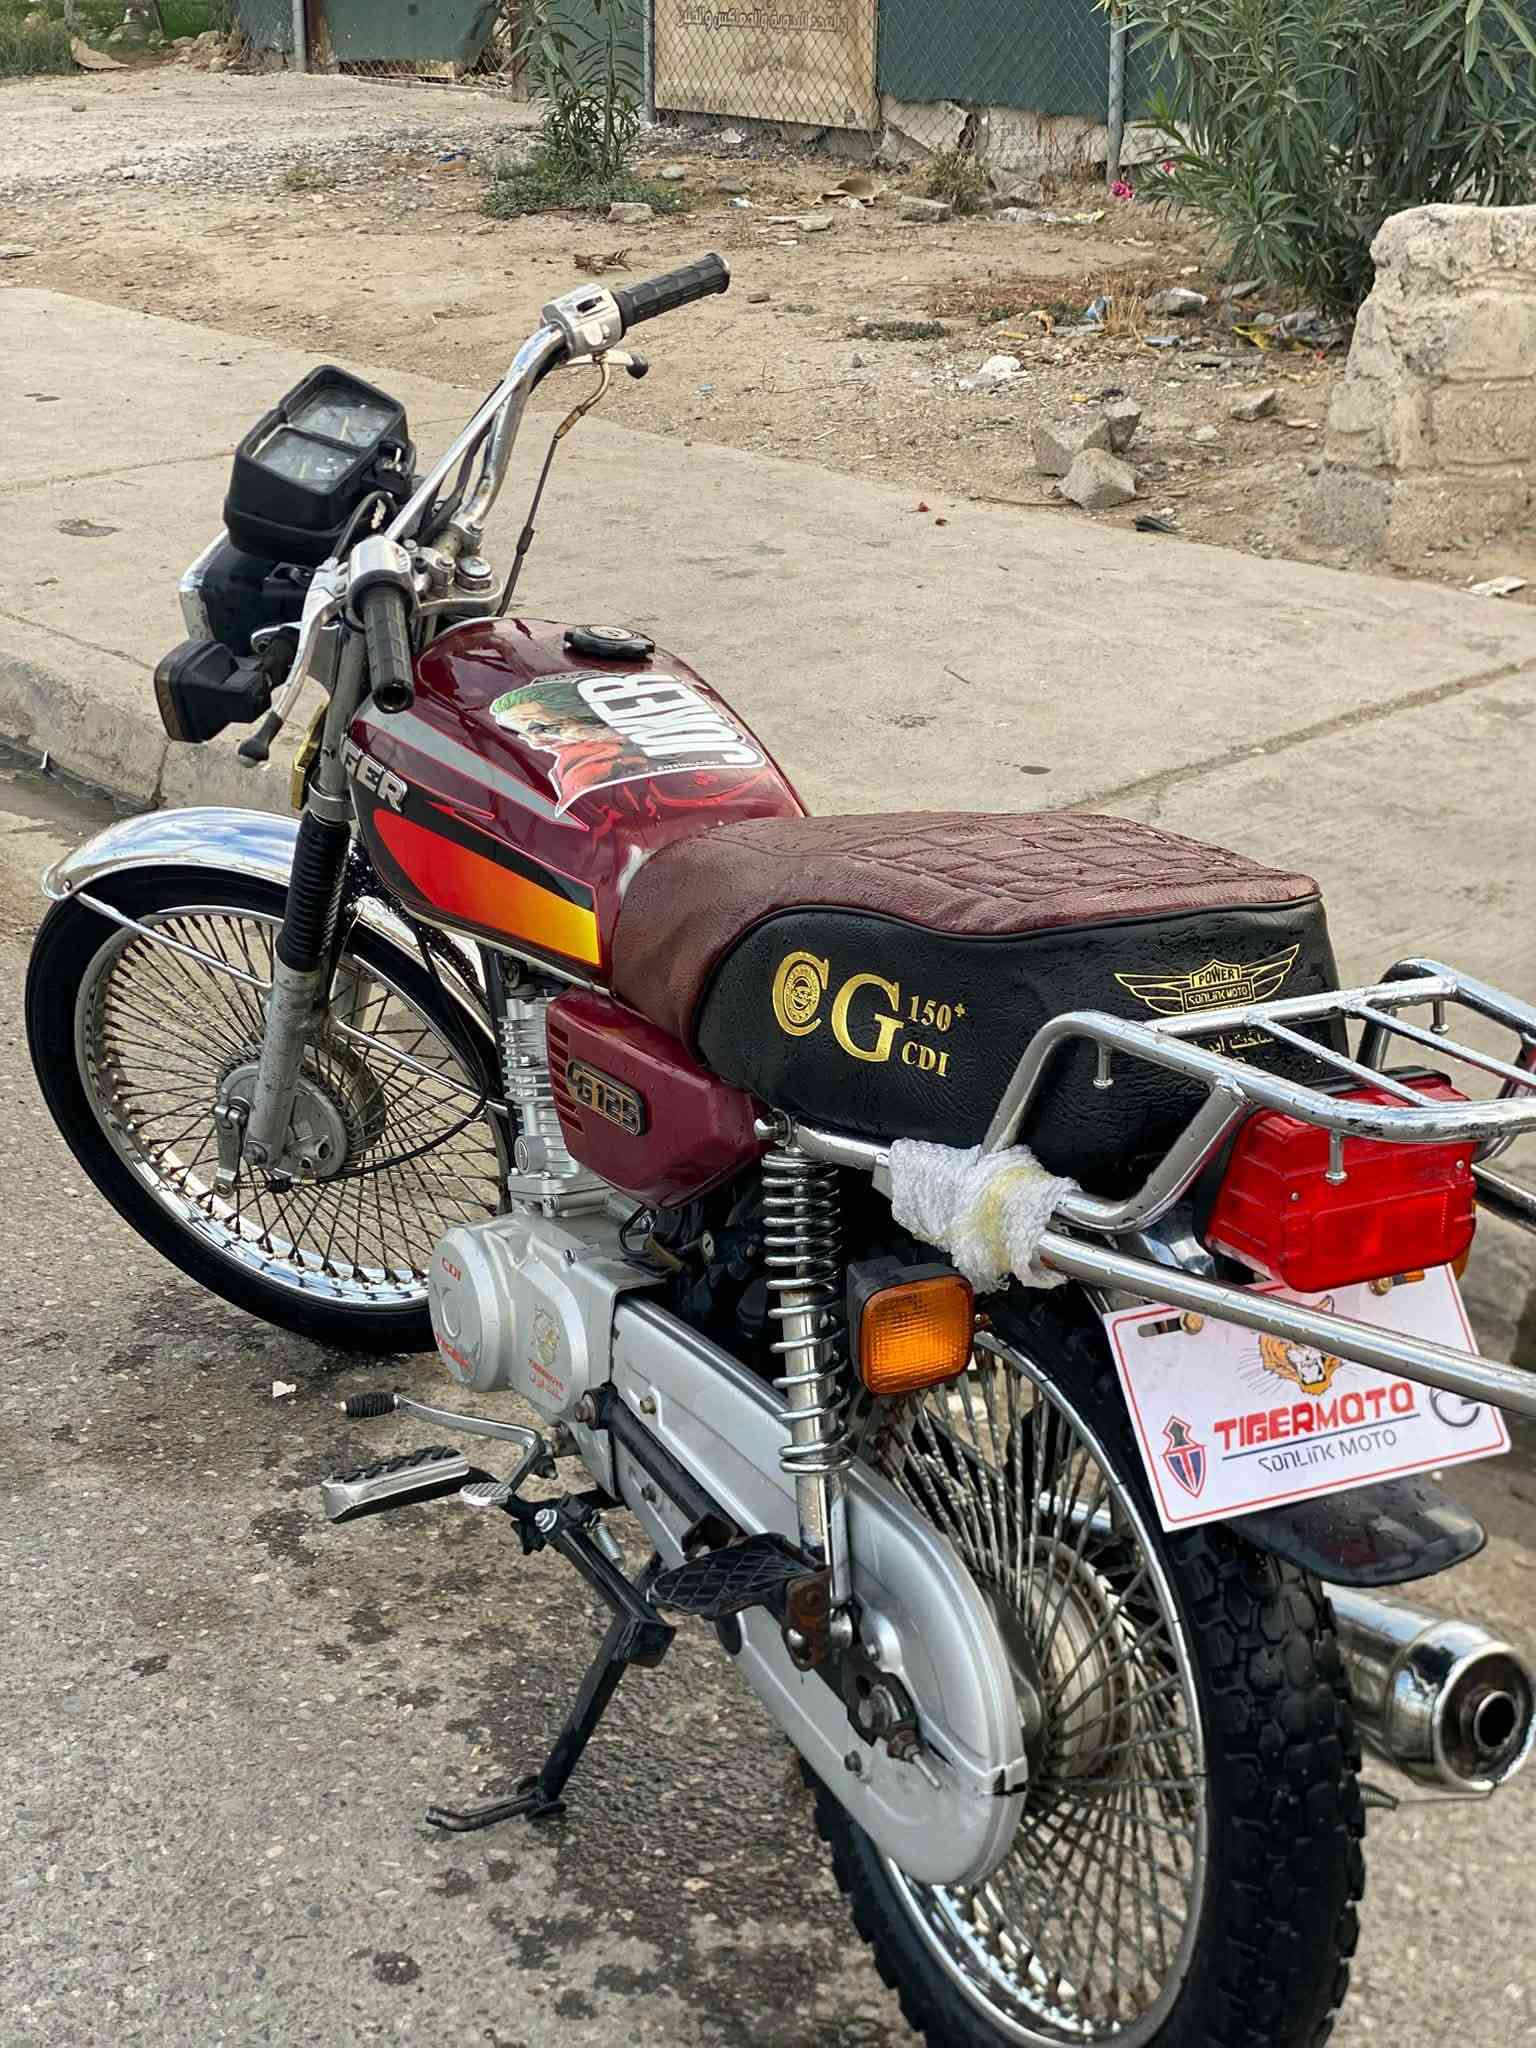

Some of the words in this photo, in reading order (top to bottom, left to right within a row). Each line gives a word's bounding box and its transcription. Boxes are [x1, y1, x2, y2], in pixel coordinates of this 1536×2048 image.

[577, 673, 758, 764] JOKER
[1199, 966, 1235, 985] POWER
[902, 1041, 950, 1077] CDI
[441, 1256, 461, 1281] CDI
[1214, 1382, 1415, 1451] TIGERMOTO
[1340, 1429, 1397, 1457] MOTO
